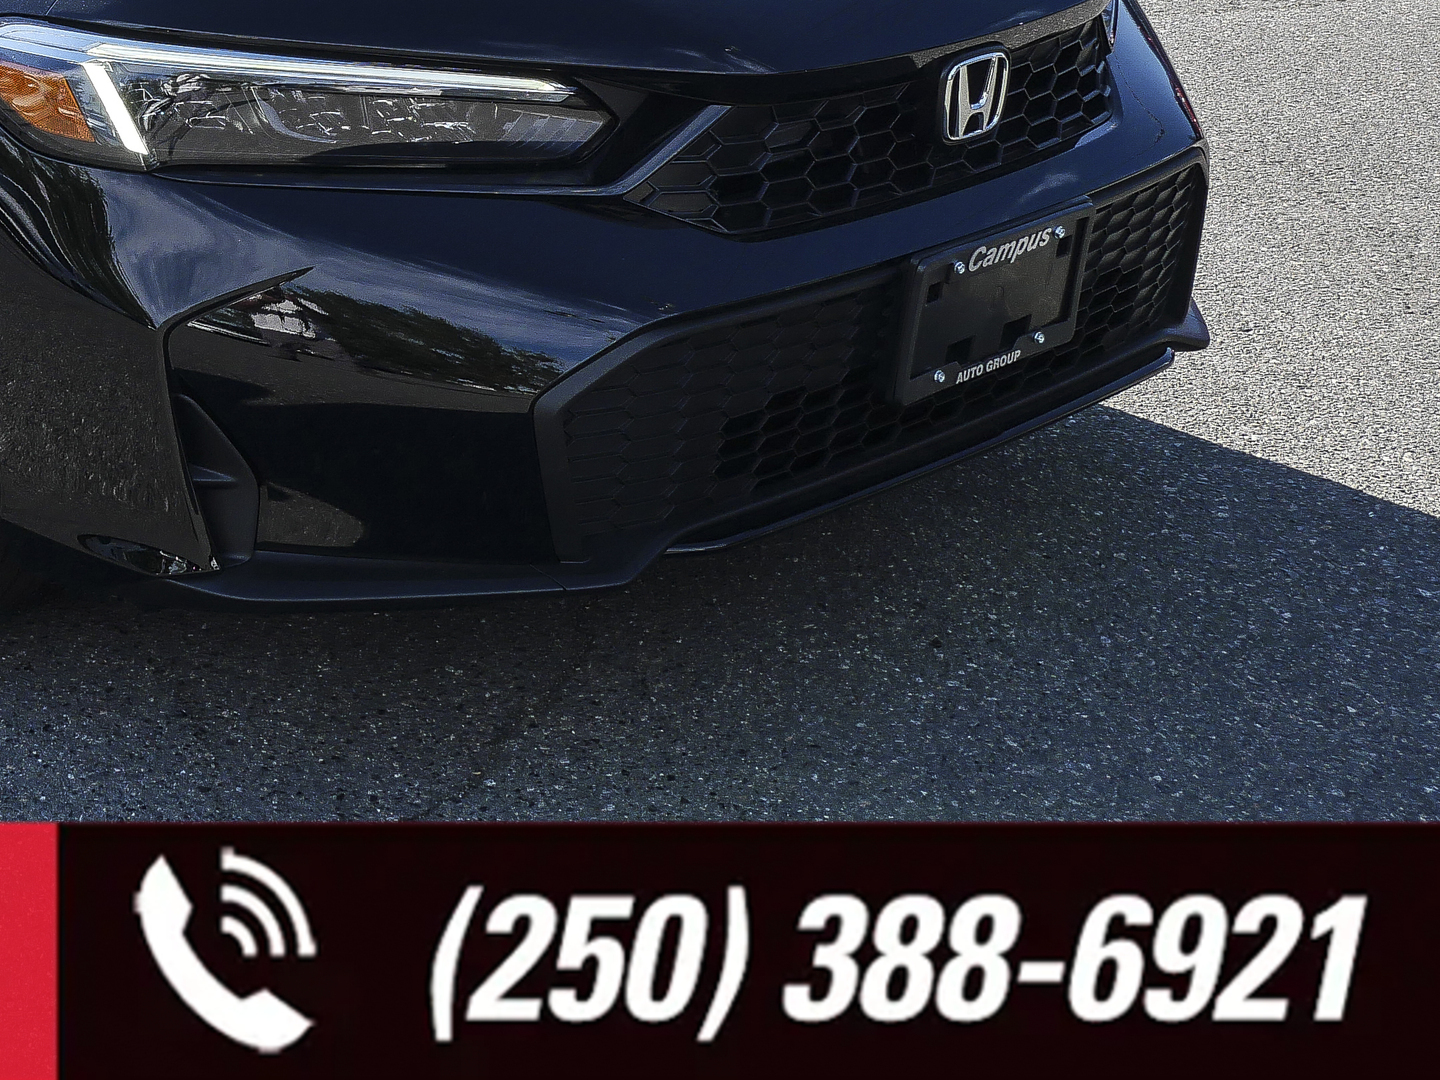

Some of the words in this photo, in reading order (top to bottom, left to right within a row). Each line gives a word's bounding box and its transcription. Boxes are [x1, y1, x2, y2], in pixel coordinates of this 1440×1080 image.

[968, 227, 1053, 273] Campus
[956, 363, 984, 385] AUTO
[985, 349, 1022, 373] GROUP
